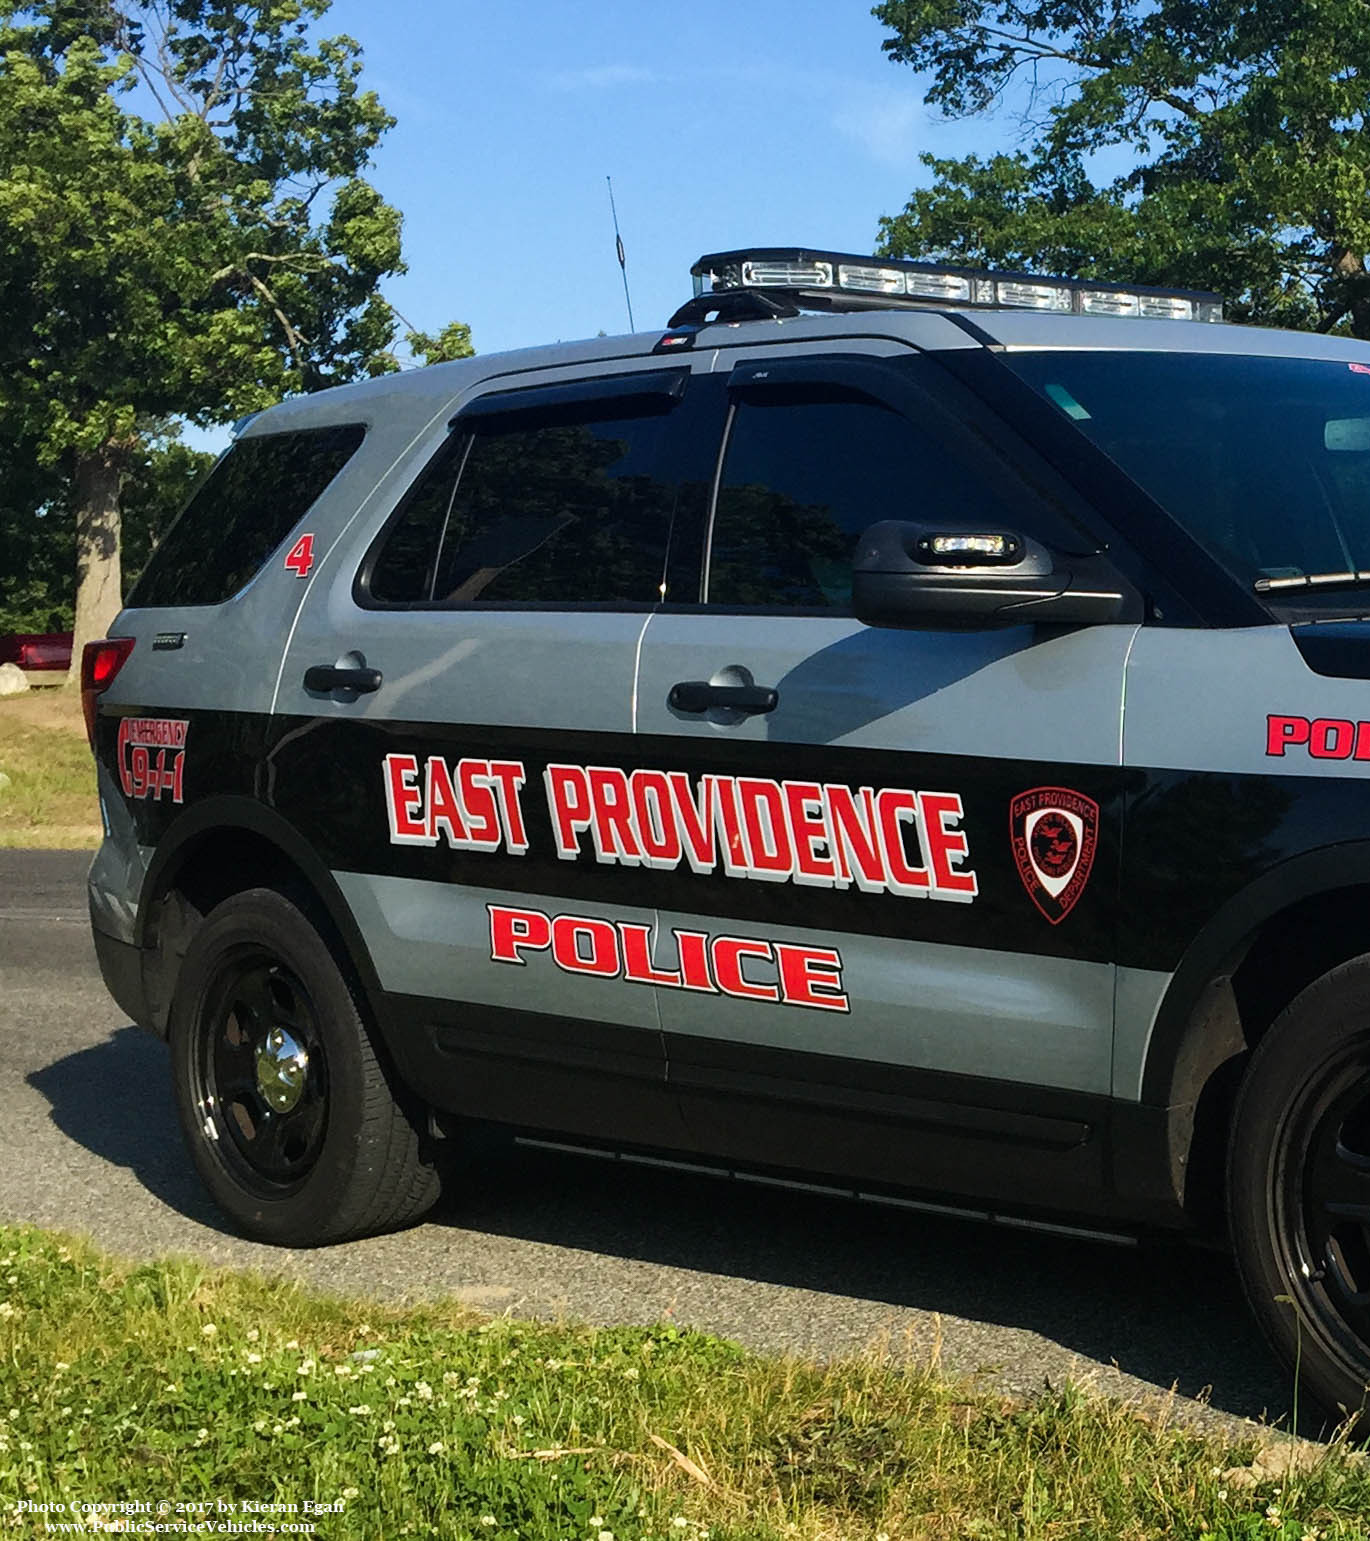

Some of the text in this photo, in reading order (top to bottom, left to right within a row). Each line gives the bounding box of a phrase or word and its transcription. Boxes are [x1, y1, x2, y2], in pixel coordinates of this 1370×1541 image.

[284, 533, 315, 578] 4
[127, 717, 189, 749] EMERGENCY
[132, 746, 185, 803] 9-1-1
[383, 753, 526, 855] EAST
[543, 763, 978, 903] PROVIDENCE
[1014, 792, 1097, 818] EAST PROVIDENCE
[1014, 836, 1041, 892] POLICE
[1058, 824, 1095, 909] DEPARTMENT
[485, 903, 851, 1014] POLICE
